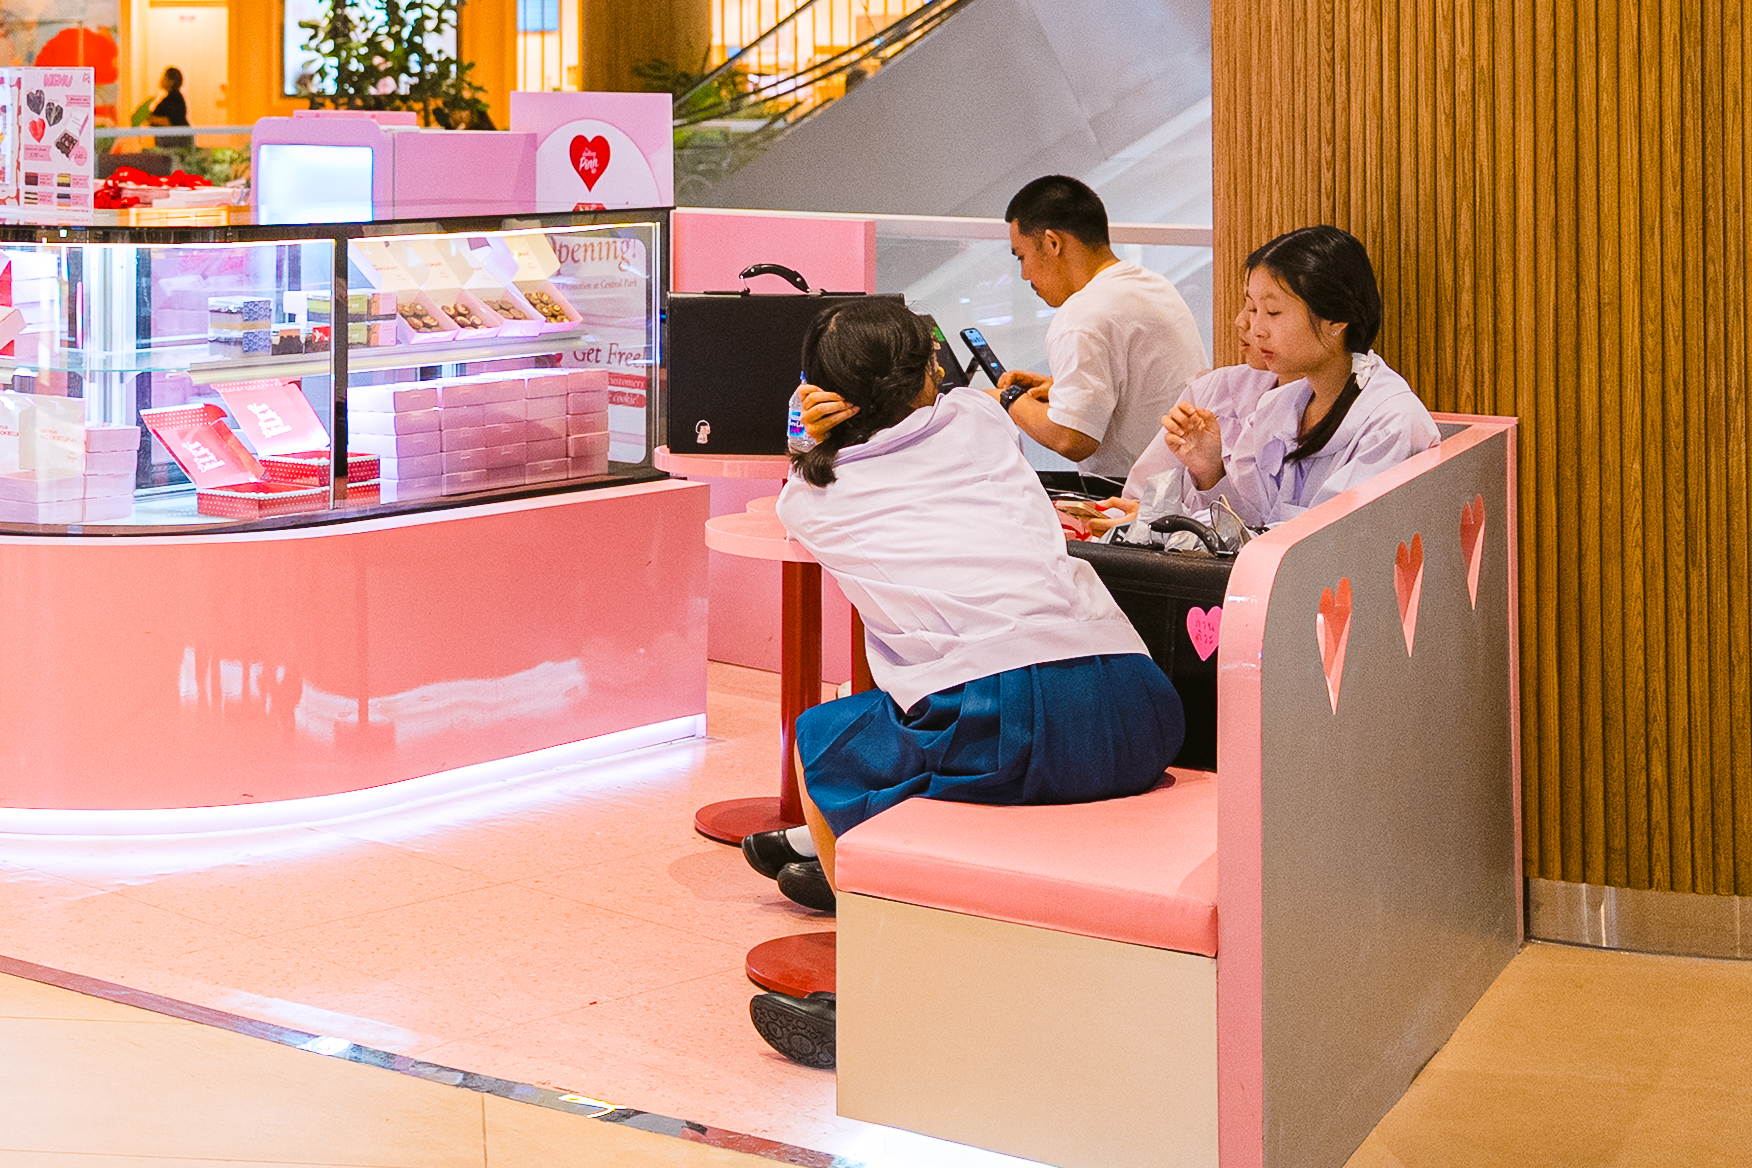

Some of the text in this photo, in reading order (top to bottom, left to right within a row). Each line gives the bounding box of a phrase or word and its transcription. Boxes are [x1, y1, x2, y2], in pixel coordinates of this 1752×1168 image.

[43, 74, 73, 88] MENU
[601, 279, 622, 289] Central
[624, 278, 637, 287] Park
